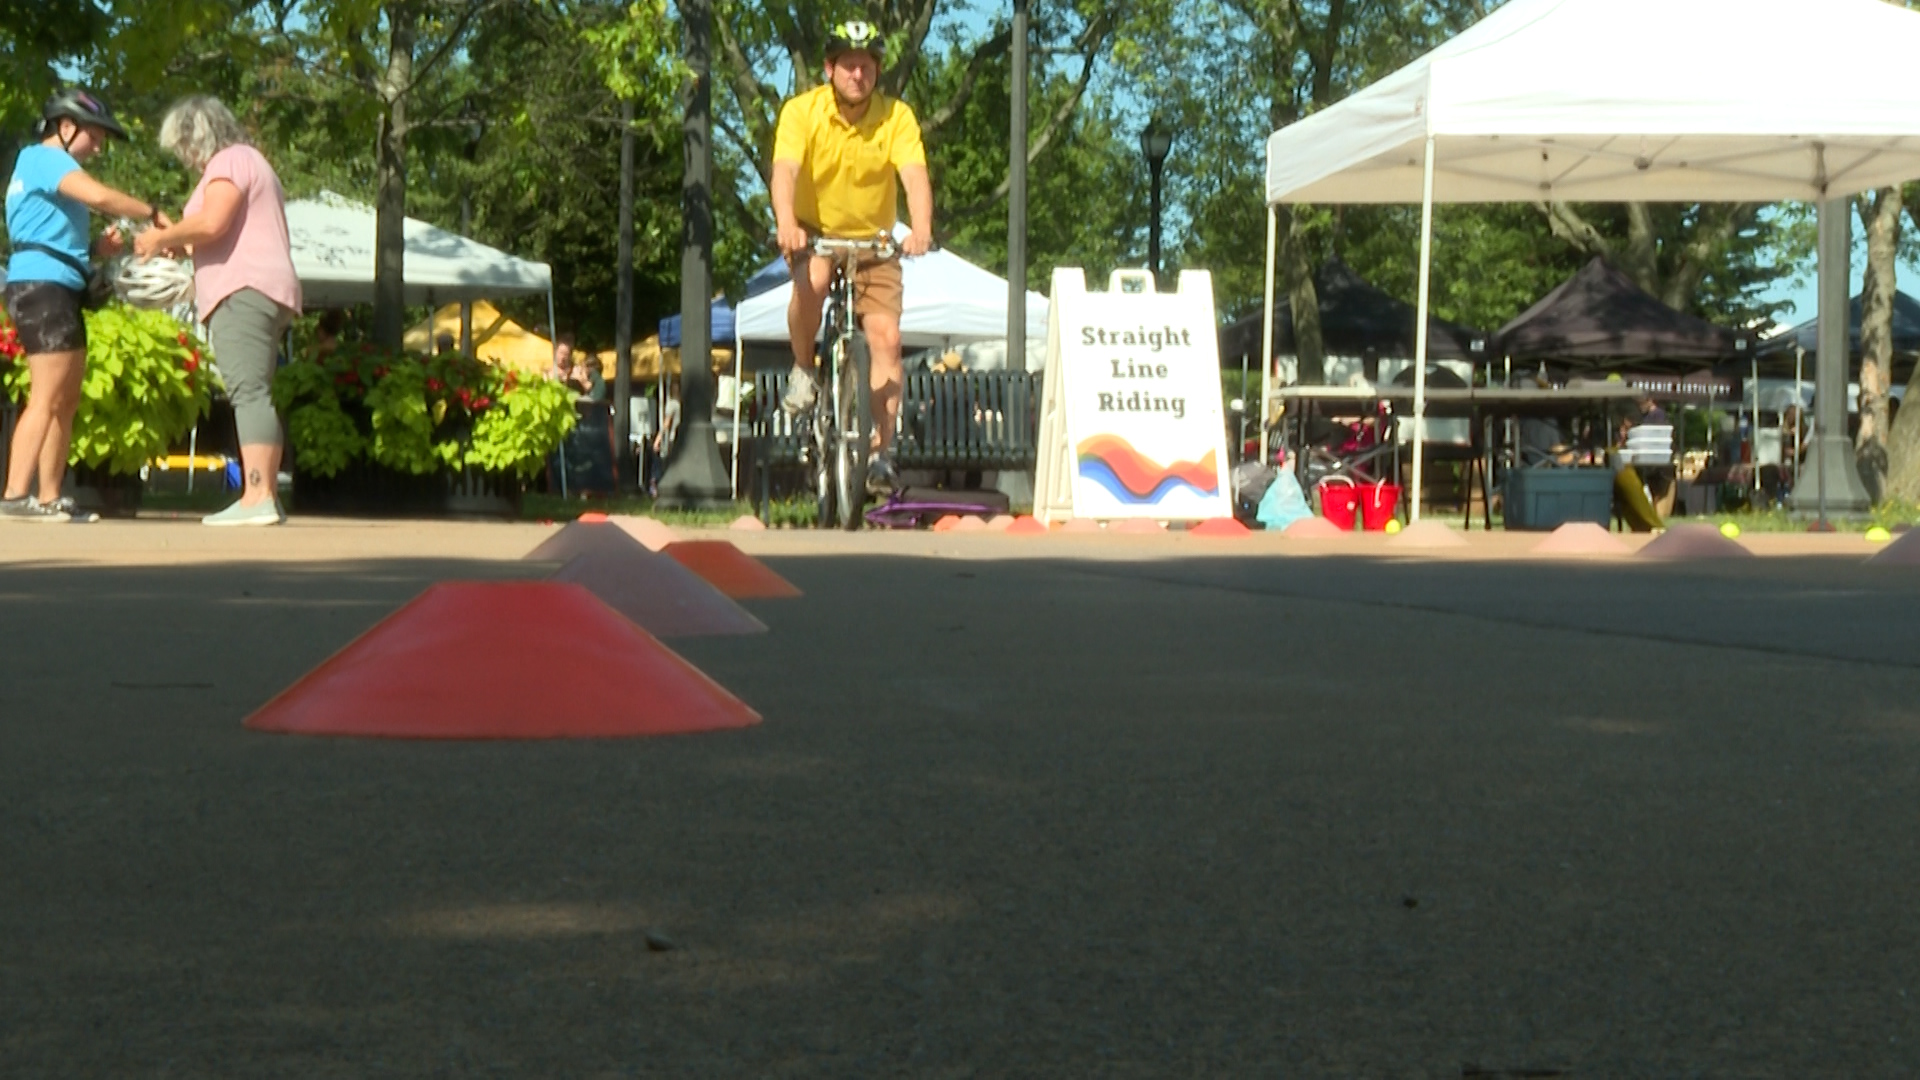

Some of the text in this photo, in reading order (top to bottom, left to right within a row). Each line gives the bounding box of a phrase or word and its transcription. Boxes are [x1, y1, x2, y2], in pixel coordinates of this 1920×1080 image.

[1081, 325, 1191, 352] Straight
[1111, 358, 1168, 379] Line
[1097, 391, 1186, 419] Riding
